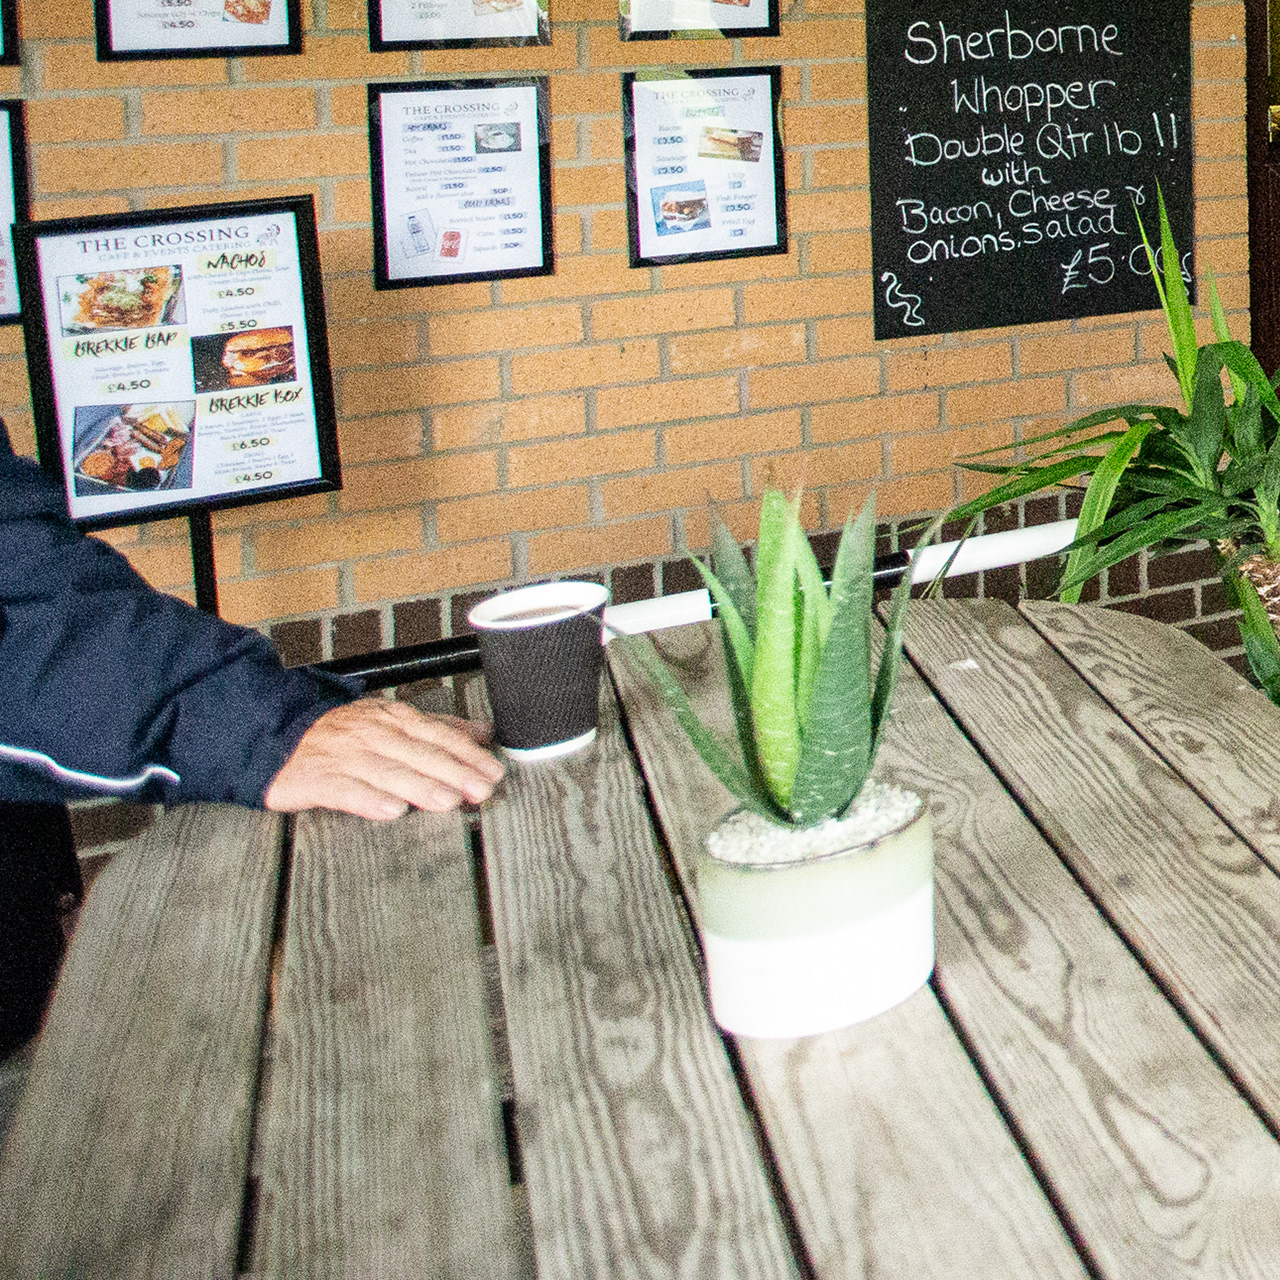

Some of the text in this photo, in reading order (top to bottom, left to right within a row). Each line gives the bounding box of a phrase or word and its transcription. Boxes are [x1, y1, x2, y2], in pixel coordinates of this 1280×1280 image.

[904, 9, 1123, 64] Sherborne
[654, 88, 739, 101] THE CROSSING
[951, 75, 1117, 122] Whopper
[402, 102, 500, 116] THE CROSSING
[905, 122, 1025, 166] Double
[1037, 122, 1094, 160] Qtr
[981, 160, 1050, 186] with
[896, 197, 1002, 234] Bacon,
[1009, 184, 1117, 217] Cheese
[1022, 205, 1128, 245] salad
[77, 226, 250, 254] THE CROSSING
[143, 247, 190, 258] EVENTS
[192, 241, 252, 254] CATERING
[206, 251, 267, 271] NACHOS
[218, 286, 255, 299] £4.50
[221, 319, 257, 331] £5.50
[75, 332, 178, 358] BREKKIE BAP
[107, 378, 151, 394] £4.50
[209, 387, 304, 414] BREKKIE BOX
[231, 436, 271, 452] £6.50
[234, 469, 274, 485] £4.50
